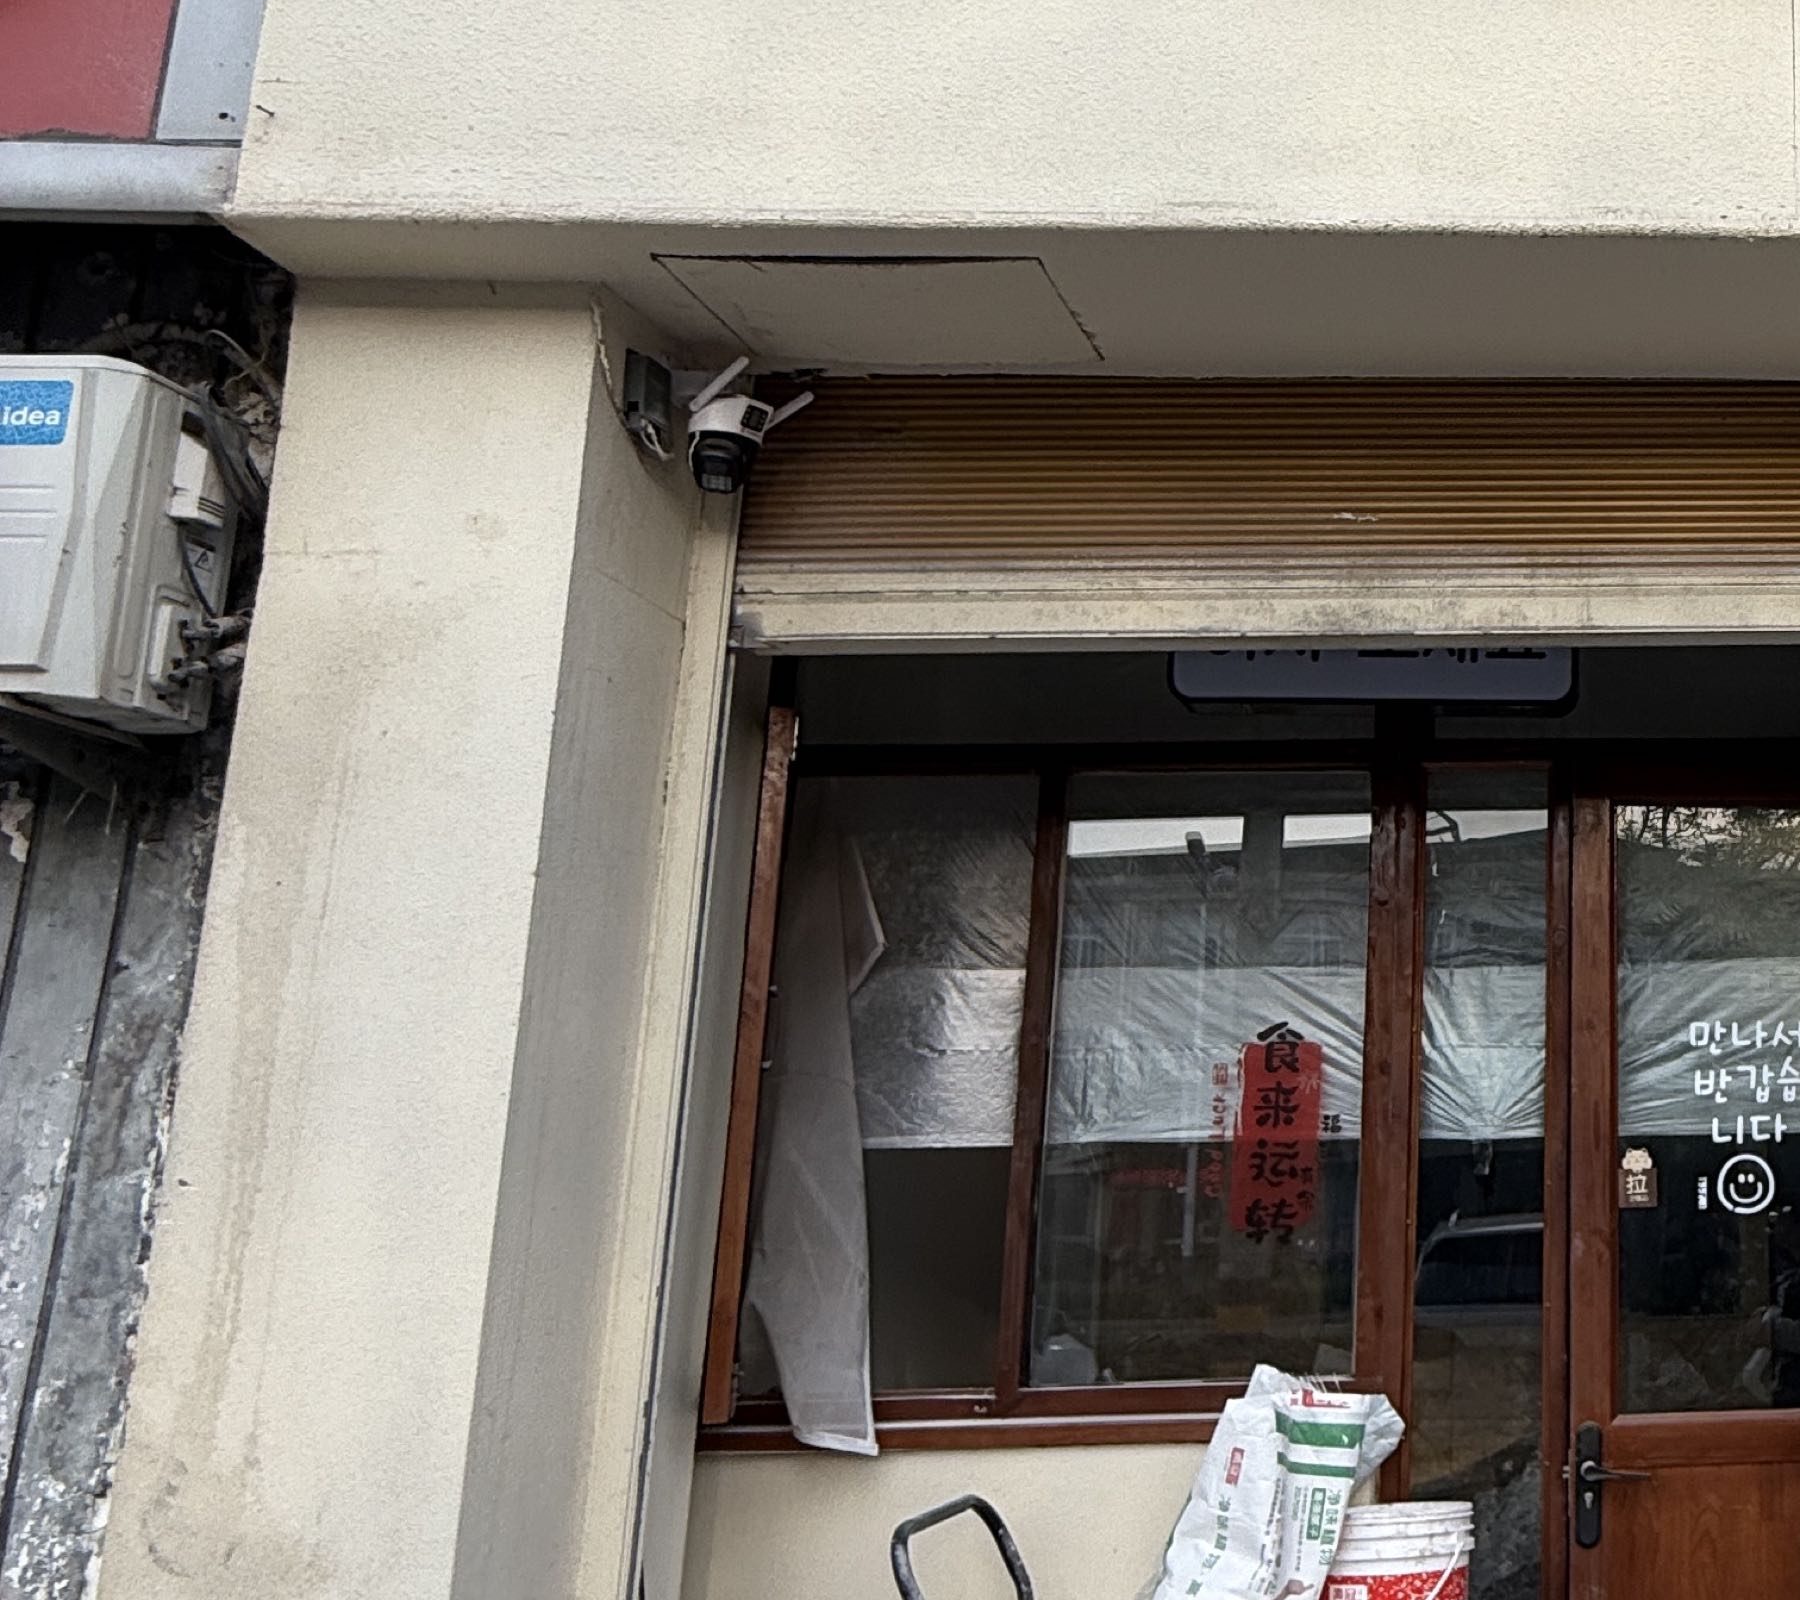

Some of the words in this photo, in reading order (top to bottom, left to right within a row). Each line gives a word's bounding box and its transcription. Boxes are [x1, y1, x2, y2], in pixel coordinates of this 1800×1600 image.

[0, 406, 61, 425] idea
[1245, 1021, 1304, 1244] 食来运转
[1711, 1112, 1788, 1145] 니다
[1626, 1174, 1649, 1195] 拉
